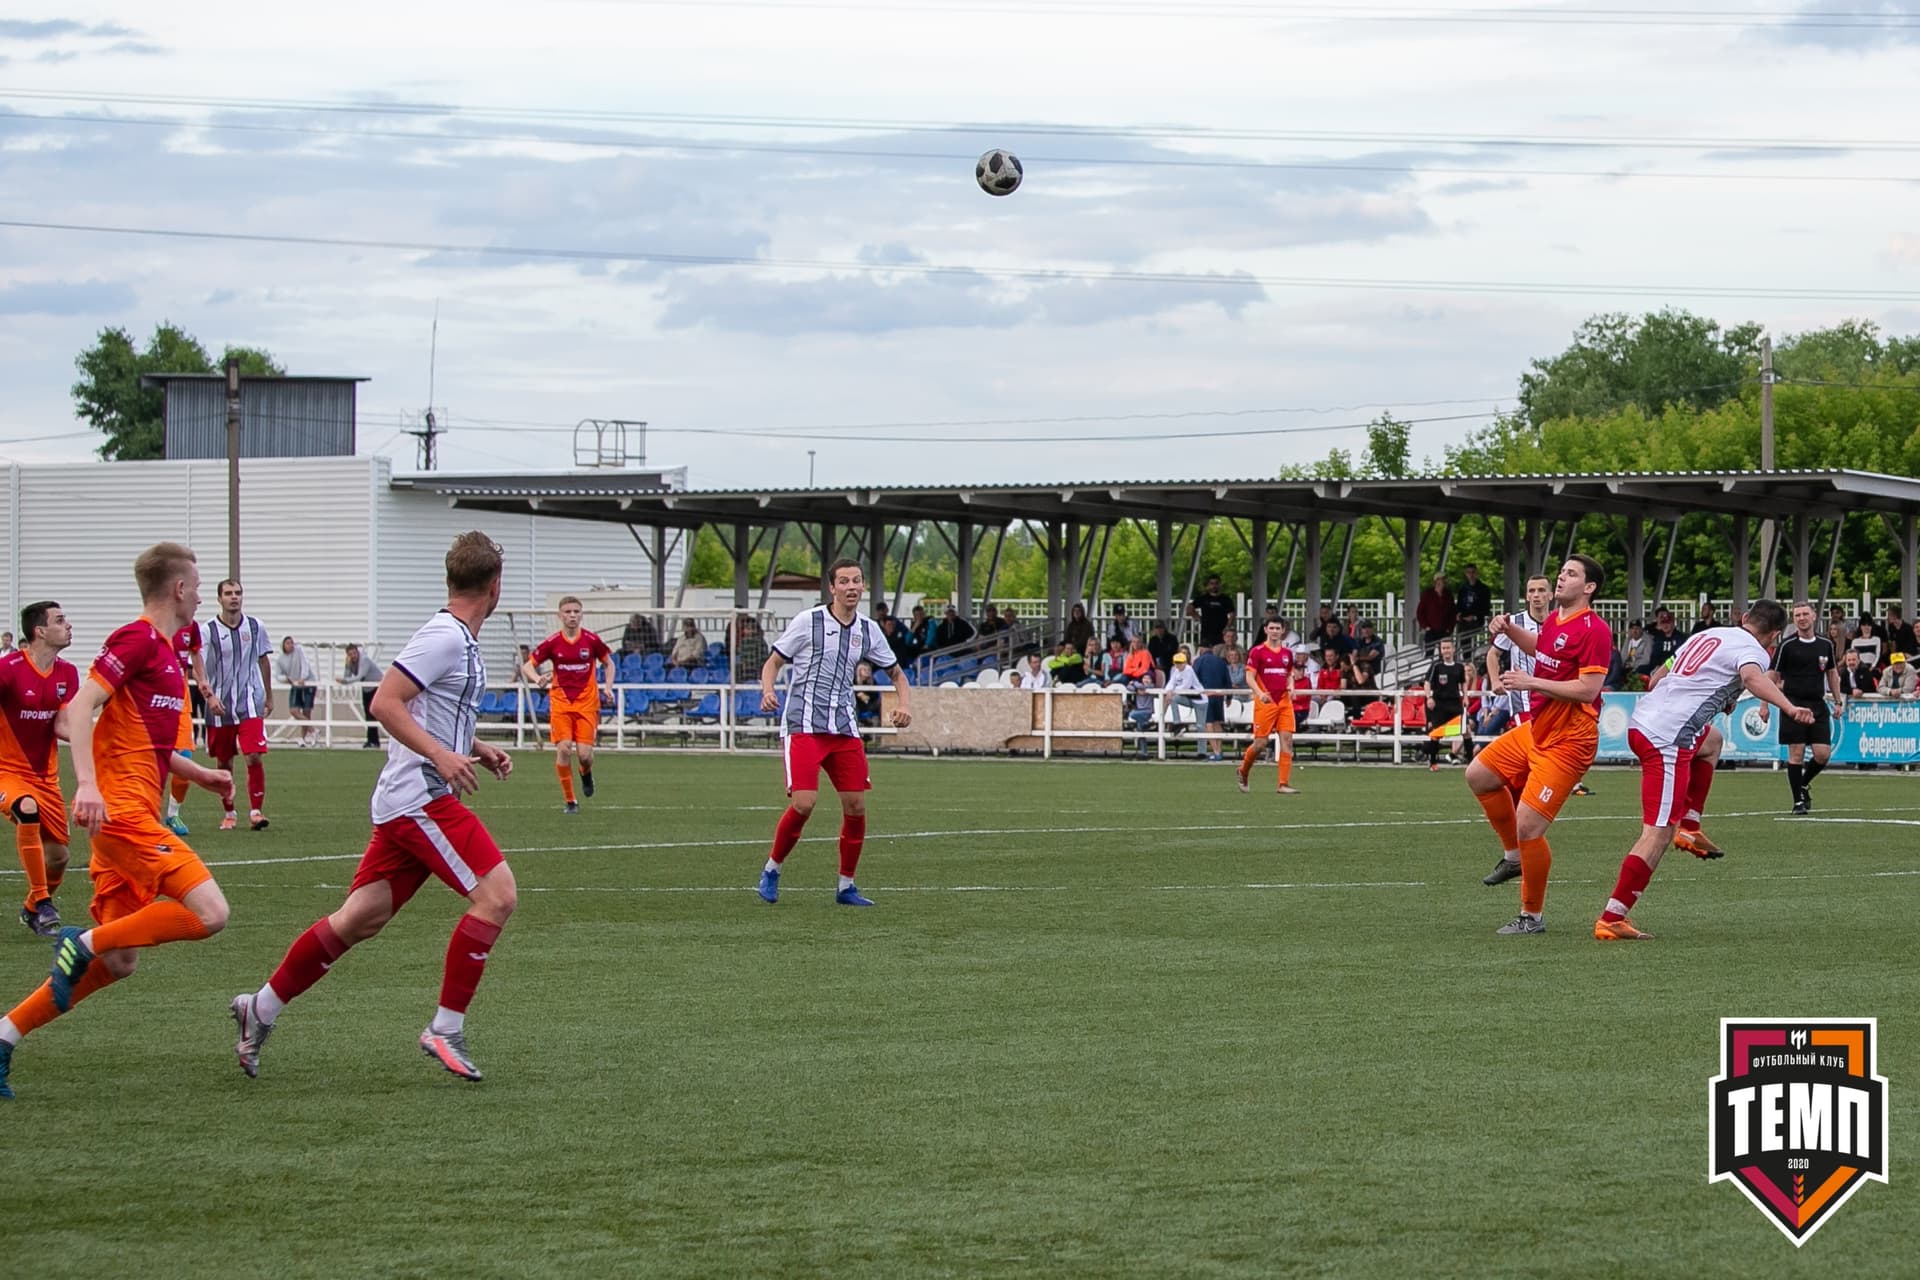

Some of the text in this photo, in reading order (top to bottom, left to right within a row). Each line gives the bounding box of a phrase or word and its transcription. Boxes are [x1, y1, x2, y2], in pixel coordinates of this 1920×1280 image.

[1672, 633, 1722, 677] 10
[1848, 702, 1920, 728] Барнаульская
[1859, 731, 1917, 758] федерация
[1539, 785, 1553, 803] 13
